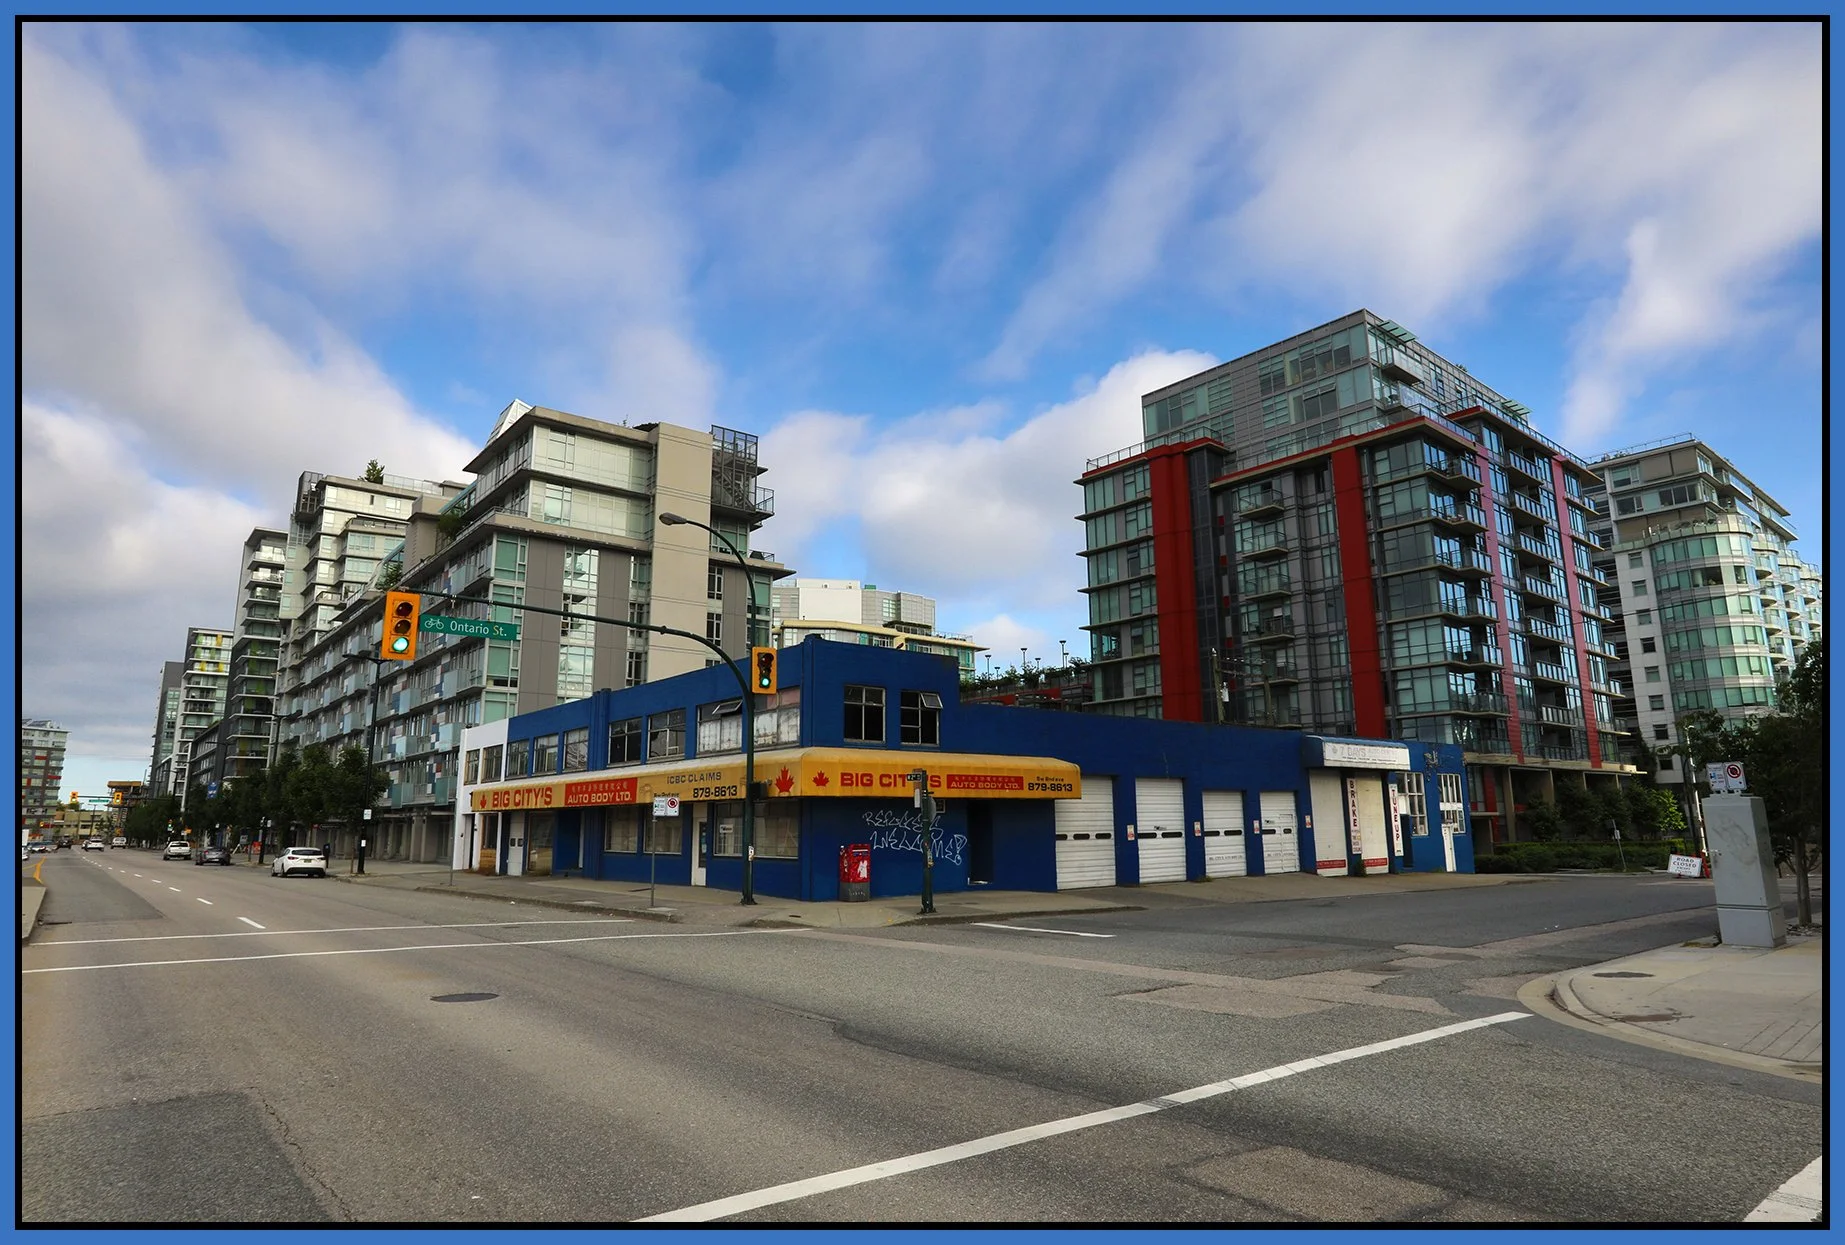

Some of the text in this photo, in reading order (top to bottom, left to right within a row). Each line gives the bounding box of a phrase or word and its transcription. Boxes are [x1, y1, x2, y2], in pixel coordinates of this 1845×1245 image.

[450, 620, 507, 637] Ontario St.
[667, 771, 722, 785] ICBC CLAIMS
[840, 772, 874, 787] BIG
[879, 773, 942, 788] CIT'S
[978, 781, 1002, 789] BODY
[492, 790, 511, 808] BIG
[514, 786, 553, 808] CITY'S
[568, 791, 633, 804] AUTO BODY LTD.
[1349, 780, 1358, 827] BRAKE
[1391, 789, 1399, 823] TUNE
[1395, 824, 1401, 842] UP
[870, 828, 968, 866] WELCME!
